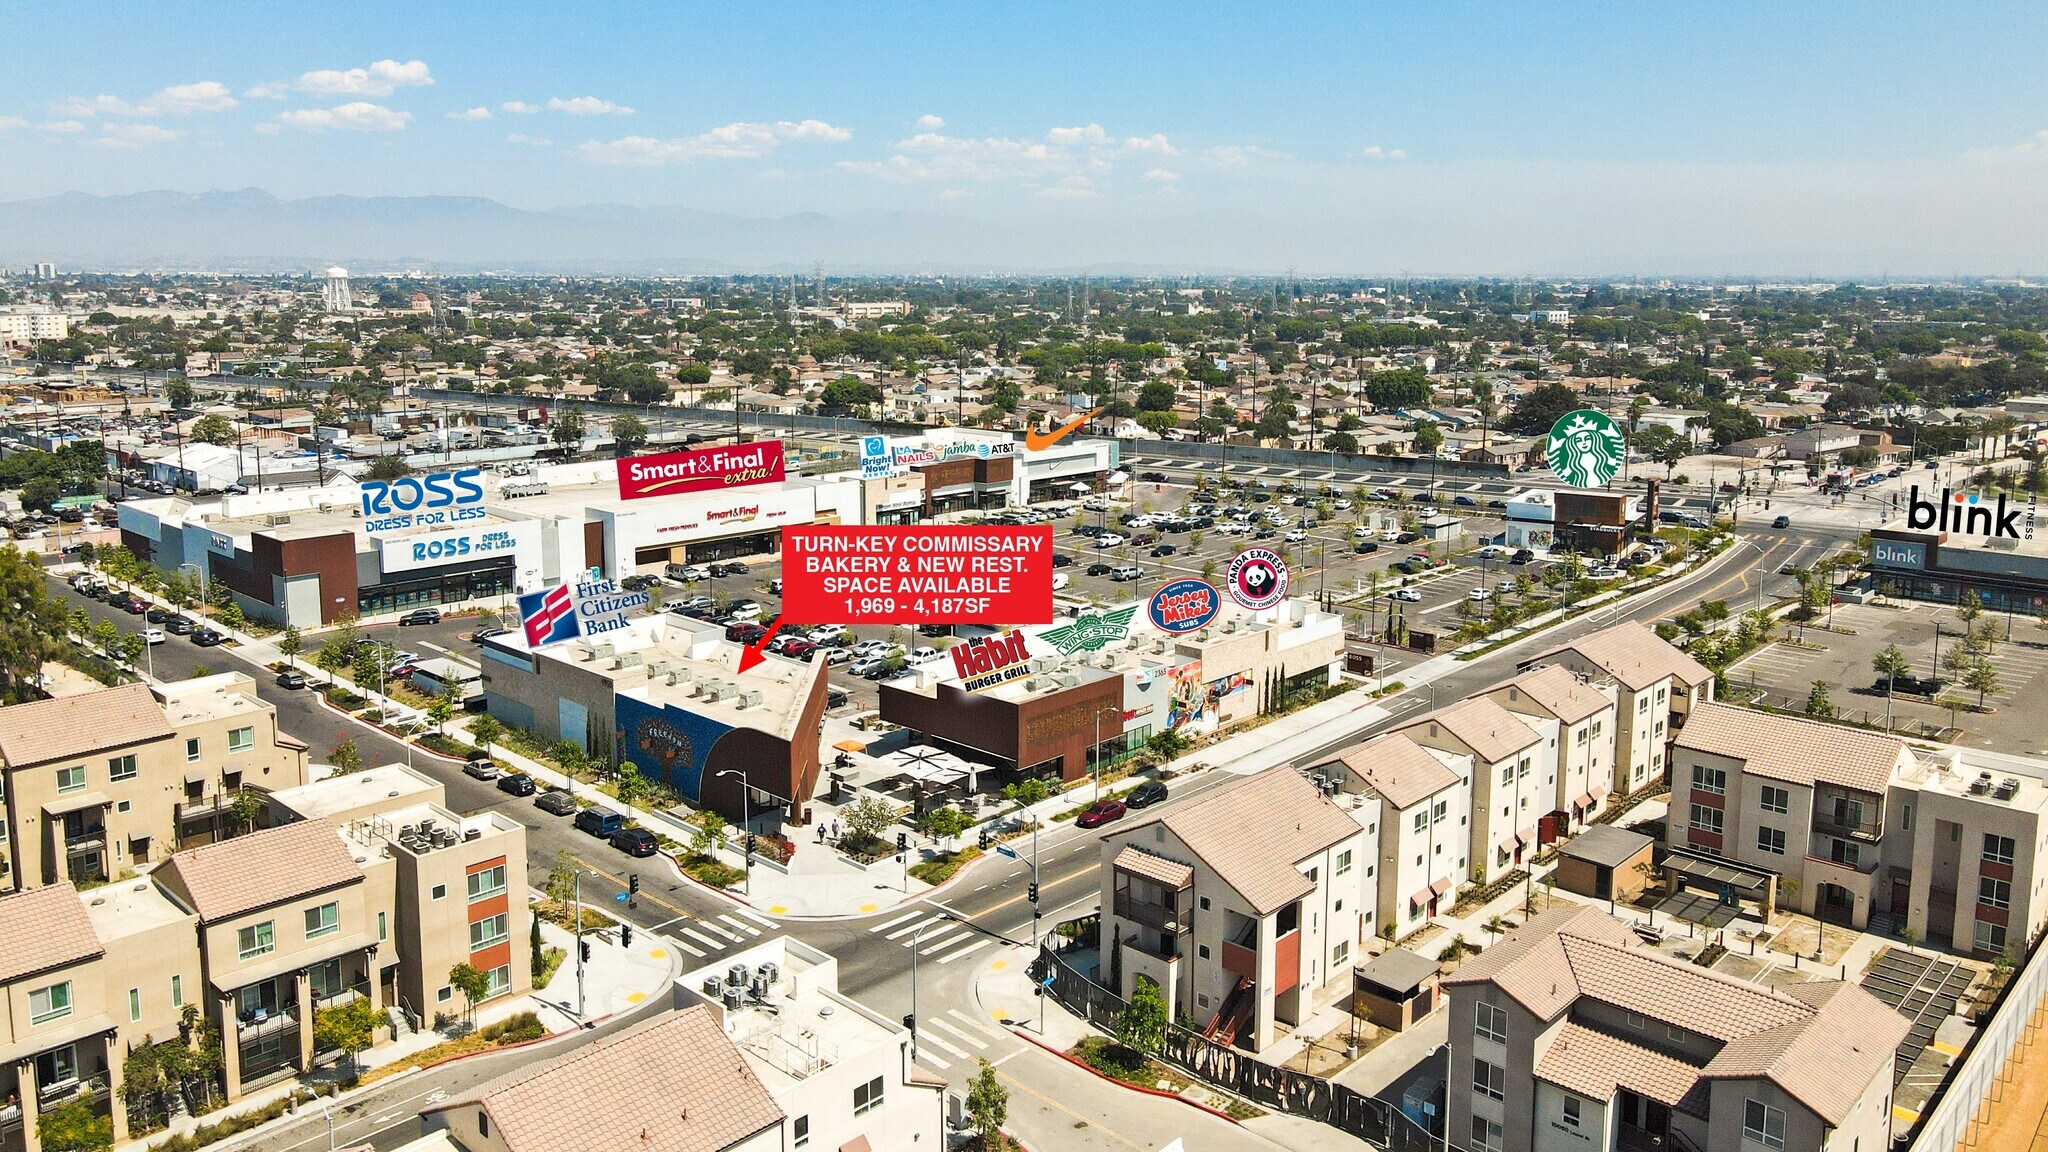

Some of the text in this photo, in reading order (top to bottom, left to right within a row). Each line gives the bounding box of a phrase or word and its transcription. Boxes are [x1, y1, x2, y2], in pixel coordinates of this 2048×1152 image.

[482, 531, 509, 544] DRESS
[412, 537, 470, 561] ROSS
[475, 538, 517, 553] FOR LESS
[1876, 545, 1917, 564] blink
[1154, 668, 1167, 678] 2365
